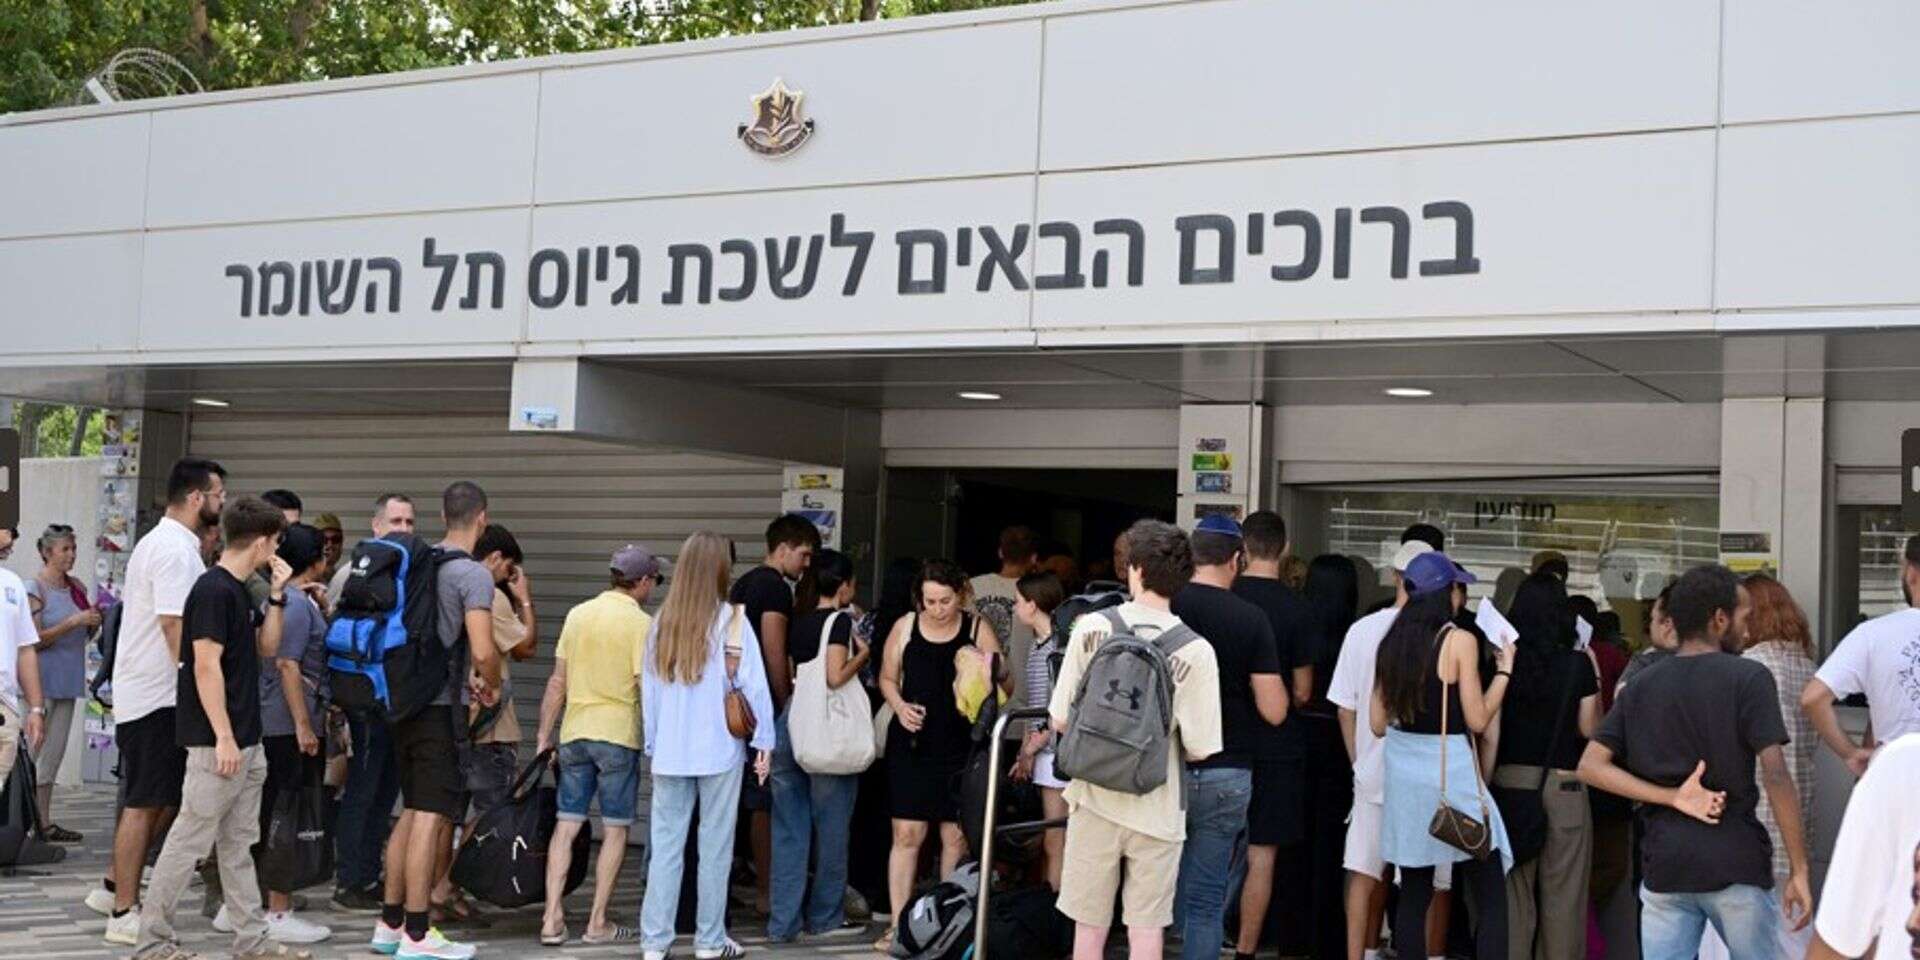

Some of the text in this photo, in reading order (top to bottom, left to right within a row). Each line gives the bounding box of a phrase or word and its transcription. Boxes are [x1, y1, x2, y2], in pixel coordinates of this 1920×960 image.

[225, 201, 1481, 318] ברוכים הבאים לשכת גיוס תל השומר
[1474, 501, 1556, 529] מודיעין
